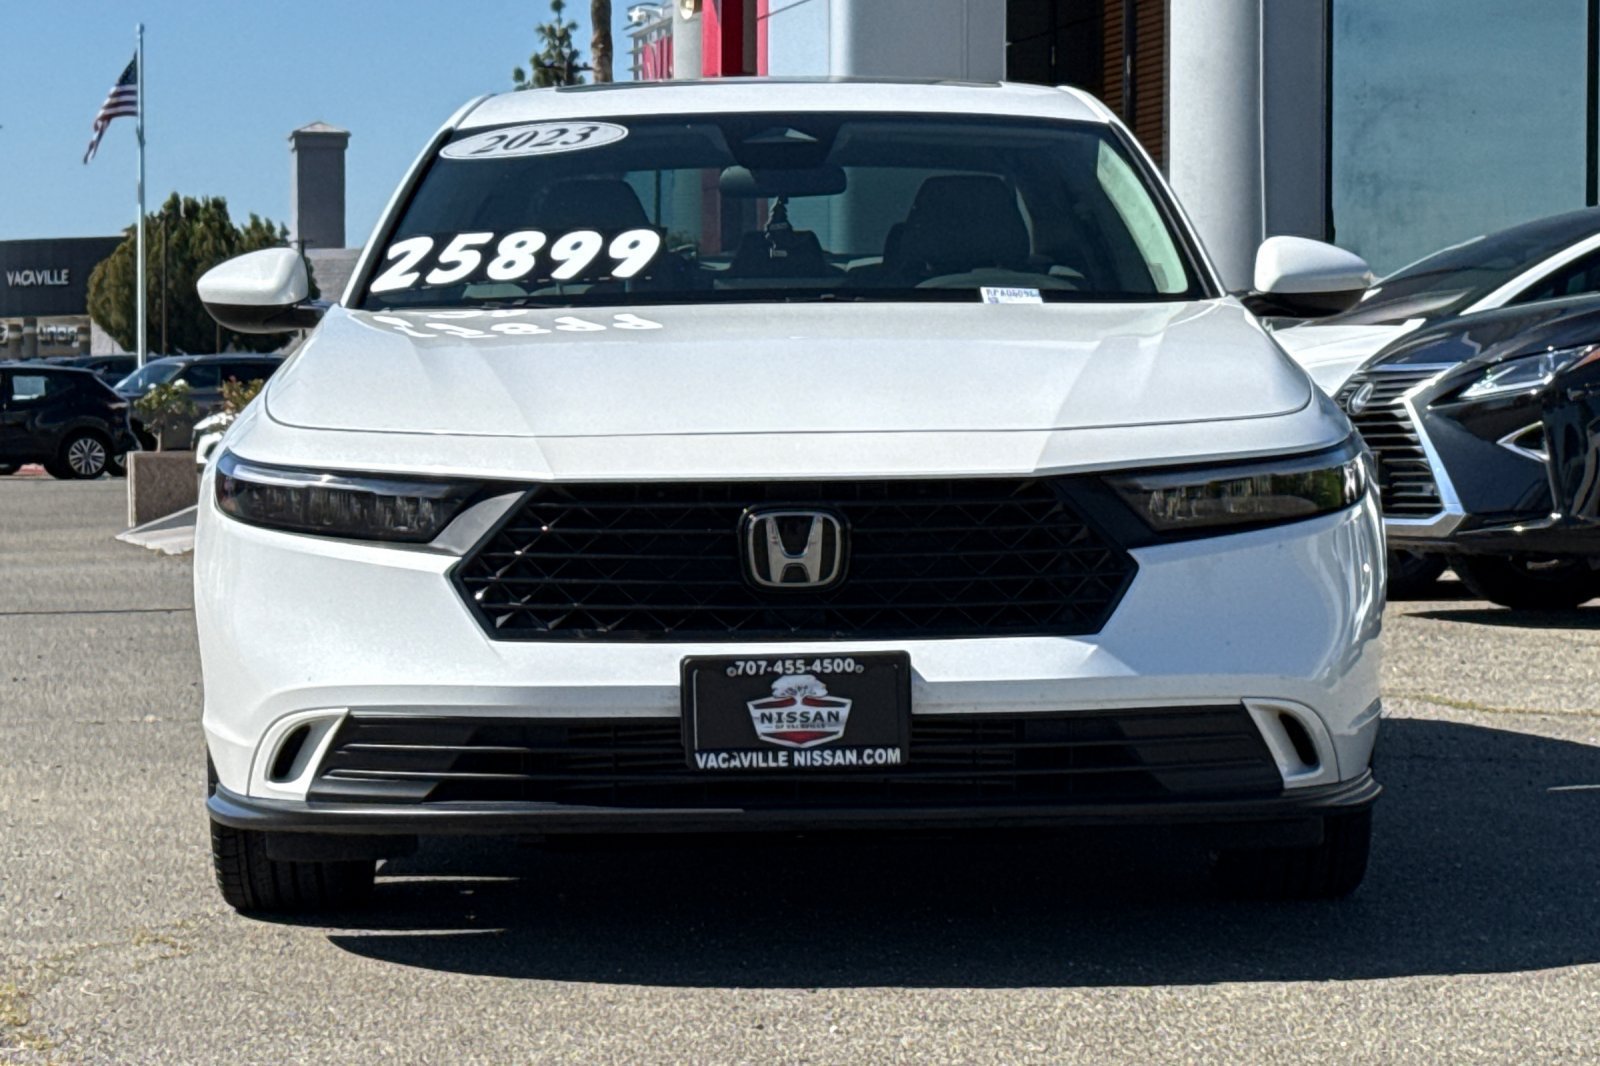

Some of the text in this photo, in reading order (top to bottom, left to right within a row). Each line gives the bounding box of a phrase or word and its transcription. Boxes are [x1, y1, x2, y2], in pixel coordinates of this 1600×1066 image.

[470, 126, 600, 155] 2023
[370, 229, 661, 293] 25899
[6, 268, 69, 287] VACAVILLE
[735, 658, 855, 675] 707-455-4500
[760, 711, 840, 724] NISSAN
[695, 748, 901, 769] VACAVILLE NISSAN.COM
